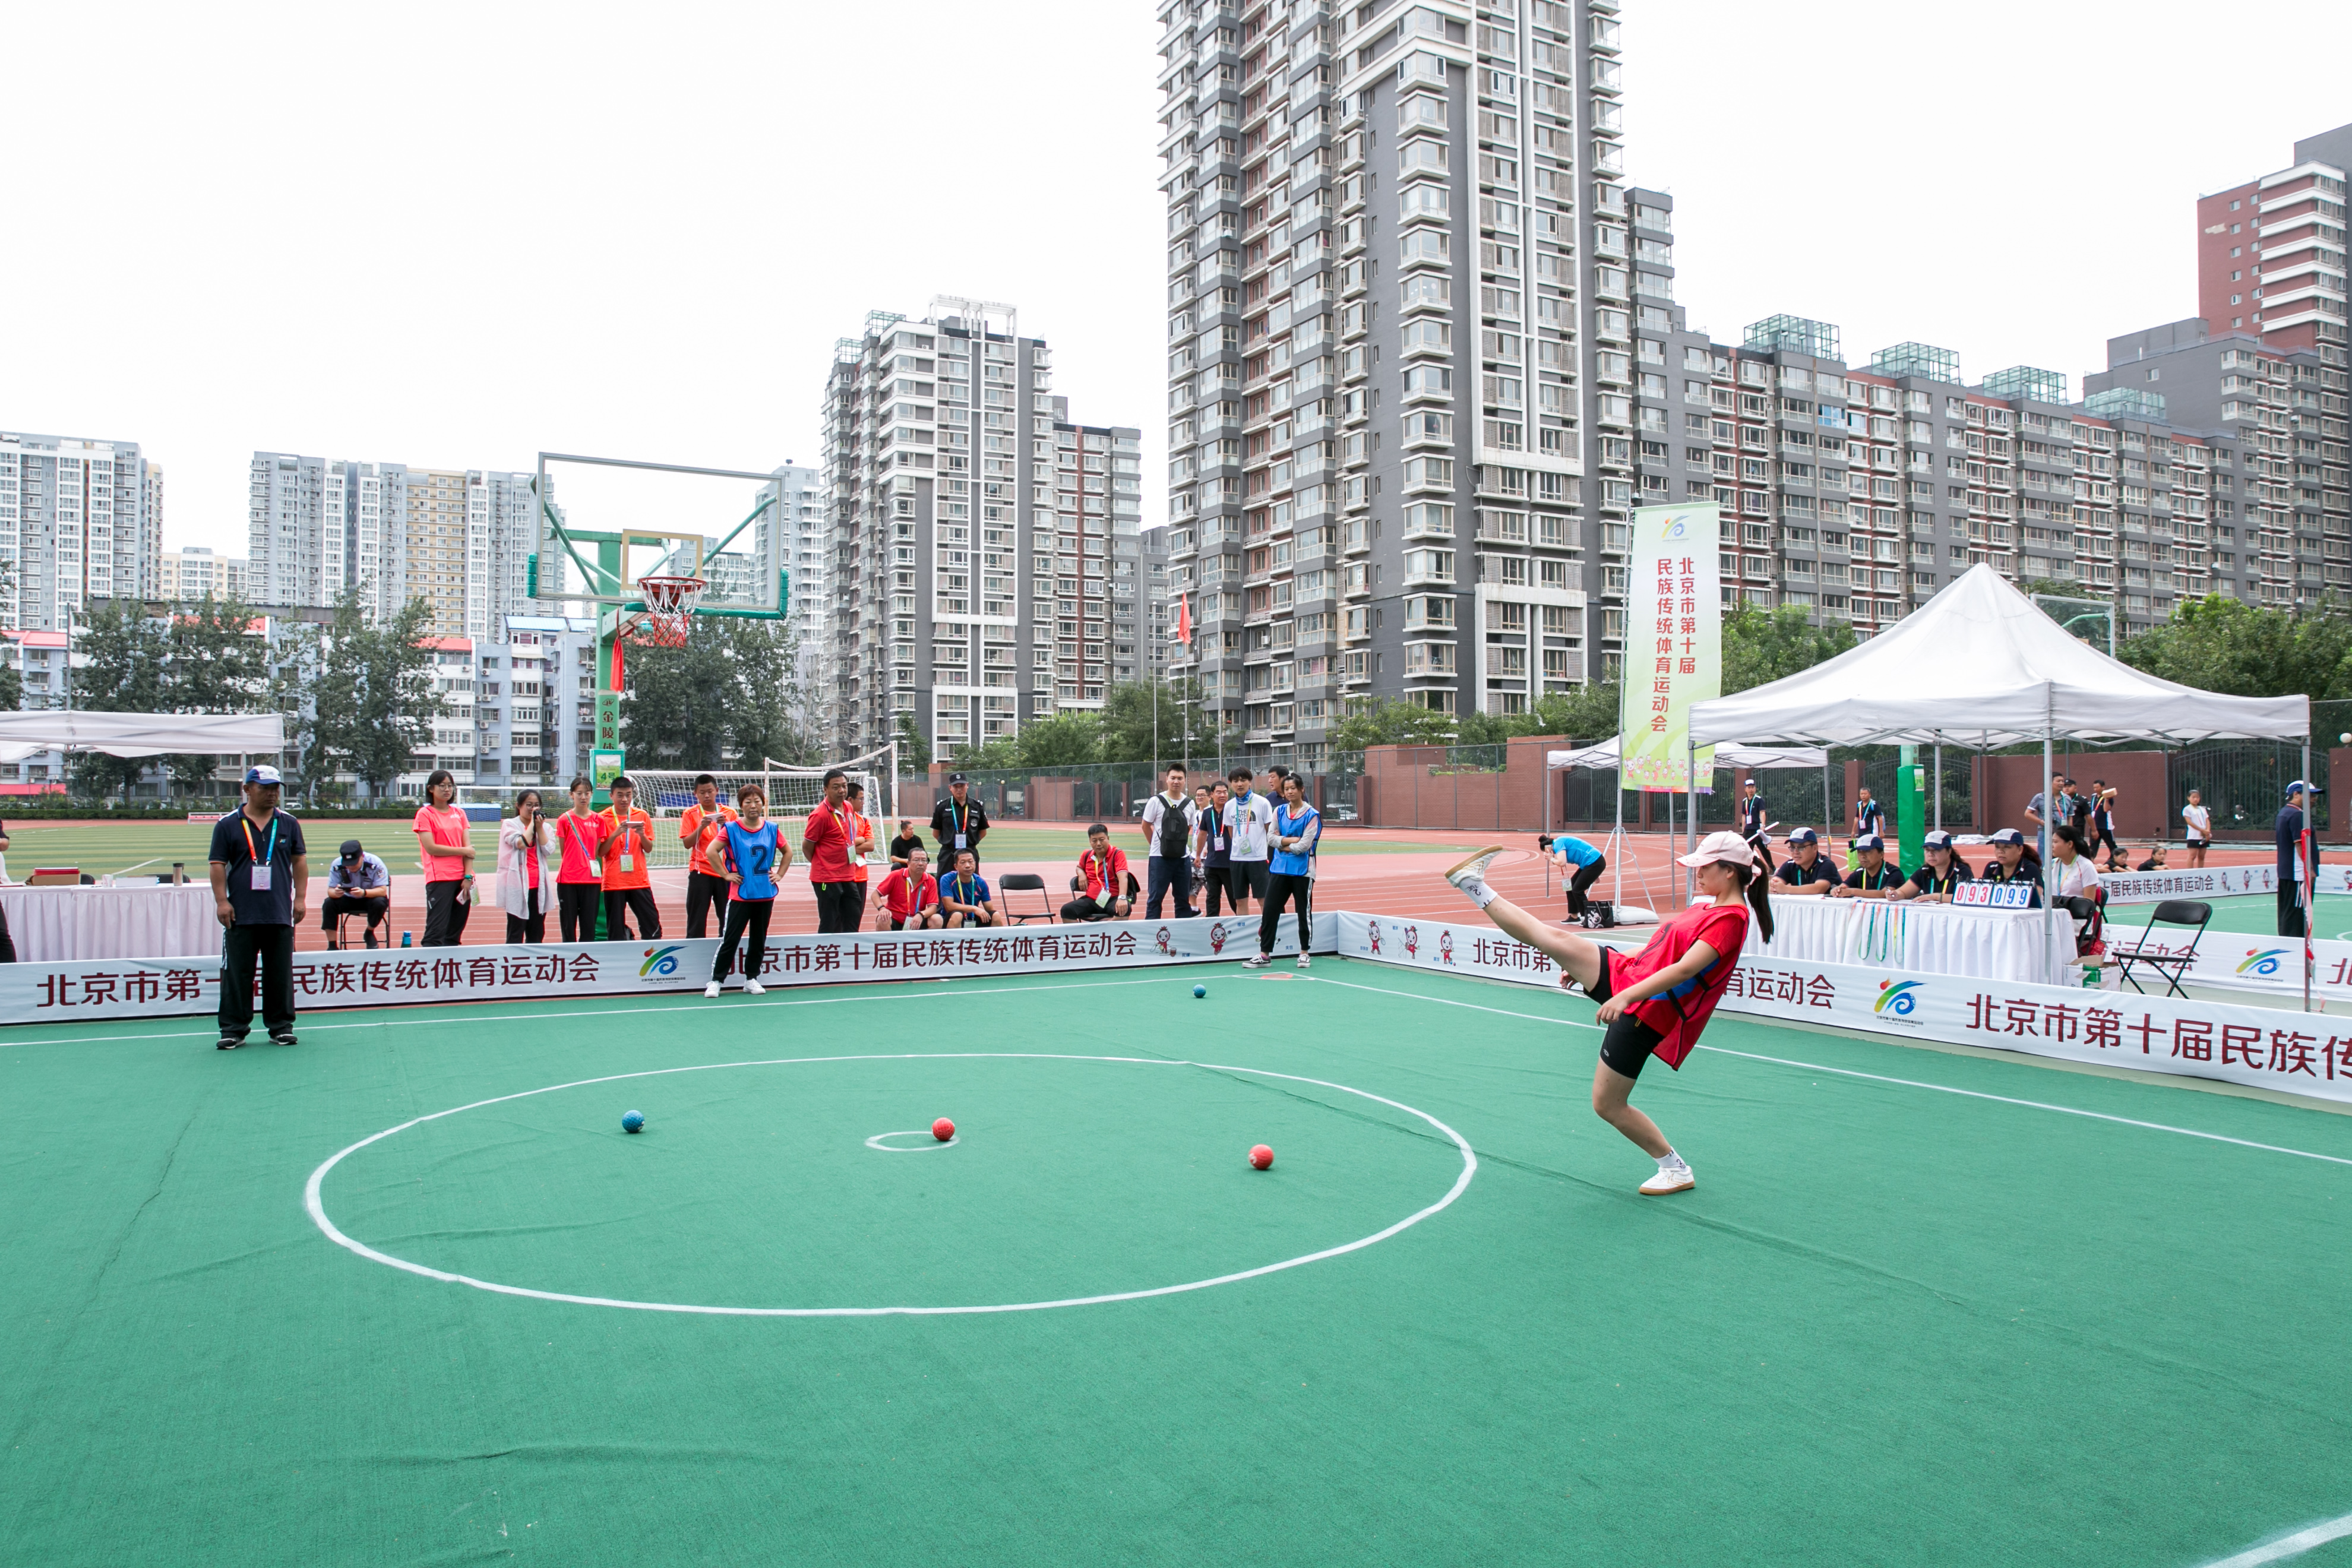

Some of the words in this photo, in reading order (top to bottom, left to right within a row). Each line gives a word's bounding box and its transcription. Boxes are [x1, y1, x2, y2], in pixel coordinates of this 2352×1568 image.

[1678, 557, 1696, 674] 北京市第十届
[1651, 558, 1674, 732] 民族传统体育运动会
[601, 772, 615, 780] 4号
[750, 844, 769, 876] 2
[1956, 885, 1989, 903] 093
[1994, 887, 2028, 905] 099
[2103, 940, 2200, 971] 运动会
[37, 952, 599, 1008] 北京市第民族传统体育运动会
